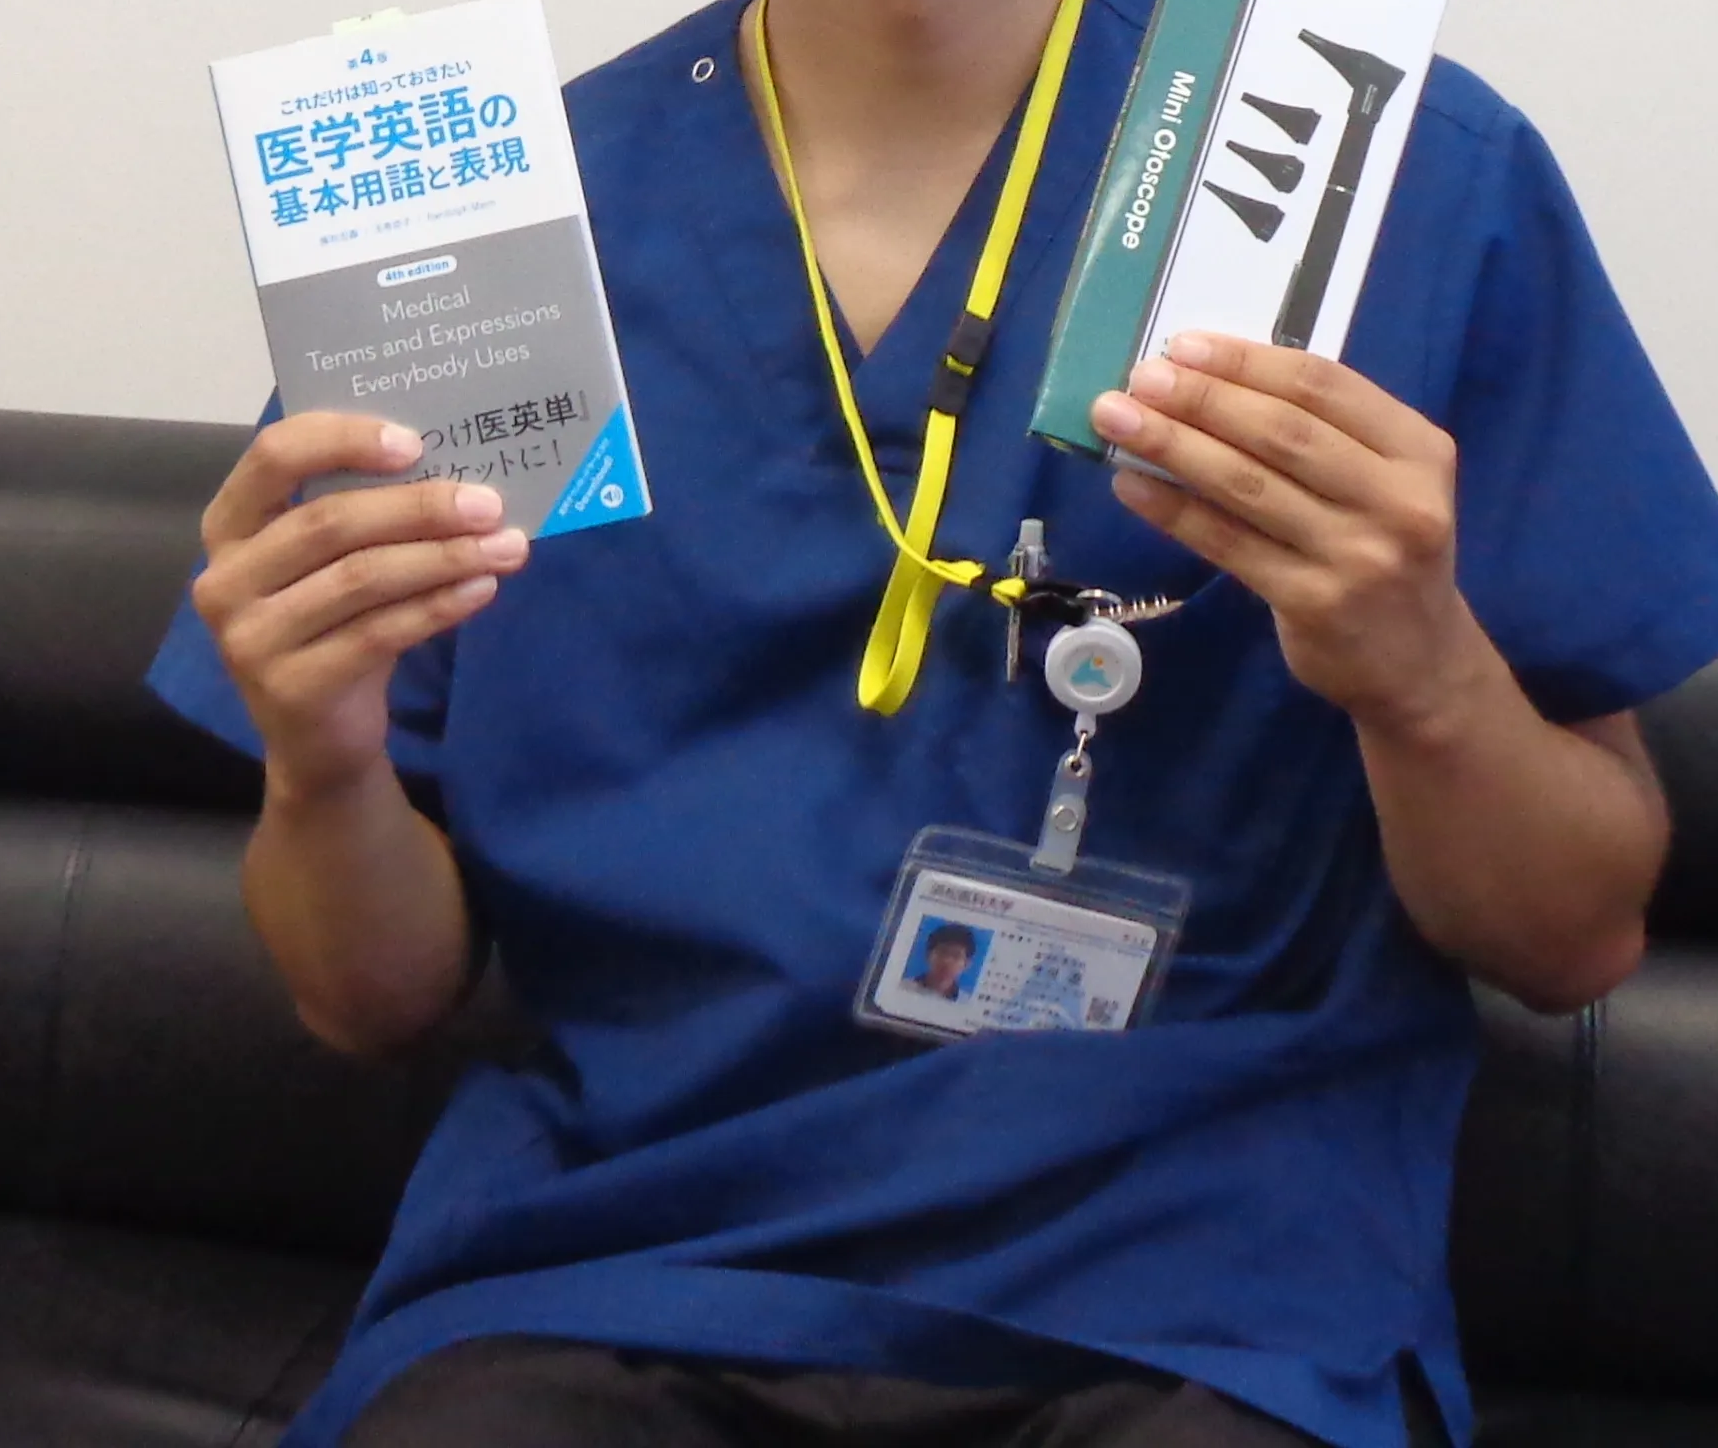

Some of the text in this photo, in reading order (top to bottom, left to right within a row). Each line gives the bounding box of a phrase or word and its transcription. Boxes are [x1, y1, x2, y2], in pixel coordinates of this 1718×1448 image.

[281, 60, 471, 115] これだけは知っておきたい
[255, 86, 517, 185] 医学英語の
[1122, 71, 1196, 249] Mini Otoscope
[269, 136, 530, 227] 基本用語と表現
[385, 259, 449, 282] 4th edition
[382, 285, 471, 323] Medical
[306, 304, 562, 371] Terms and Expressions
[351, 344, 530, 397] Everybody Uses
